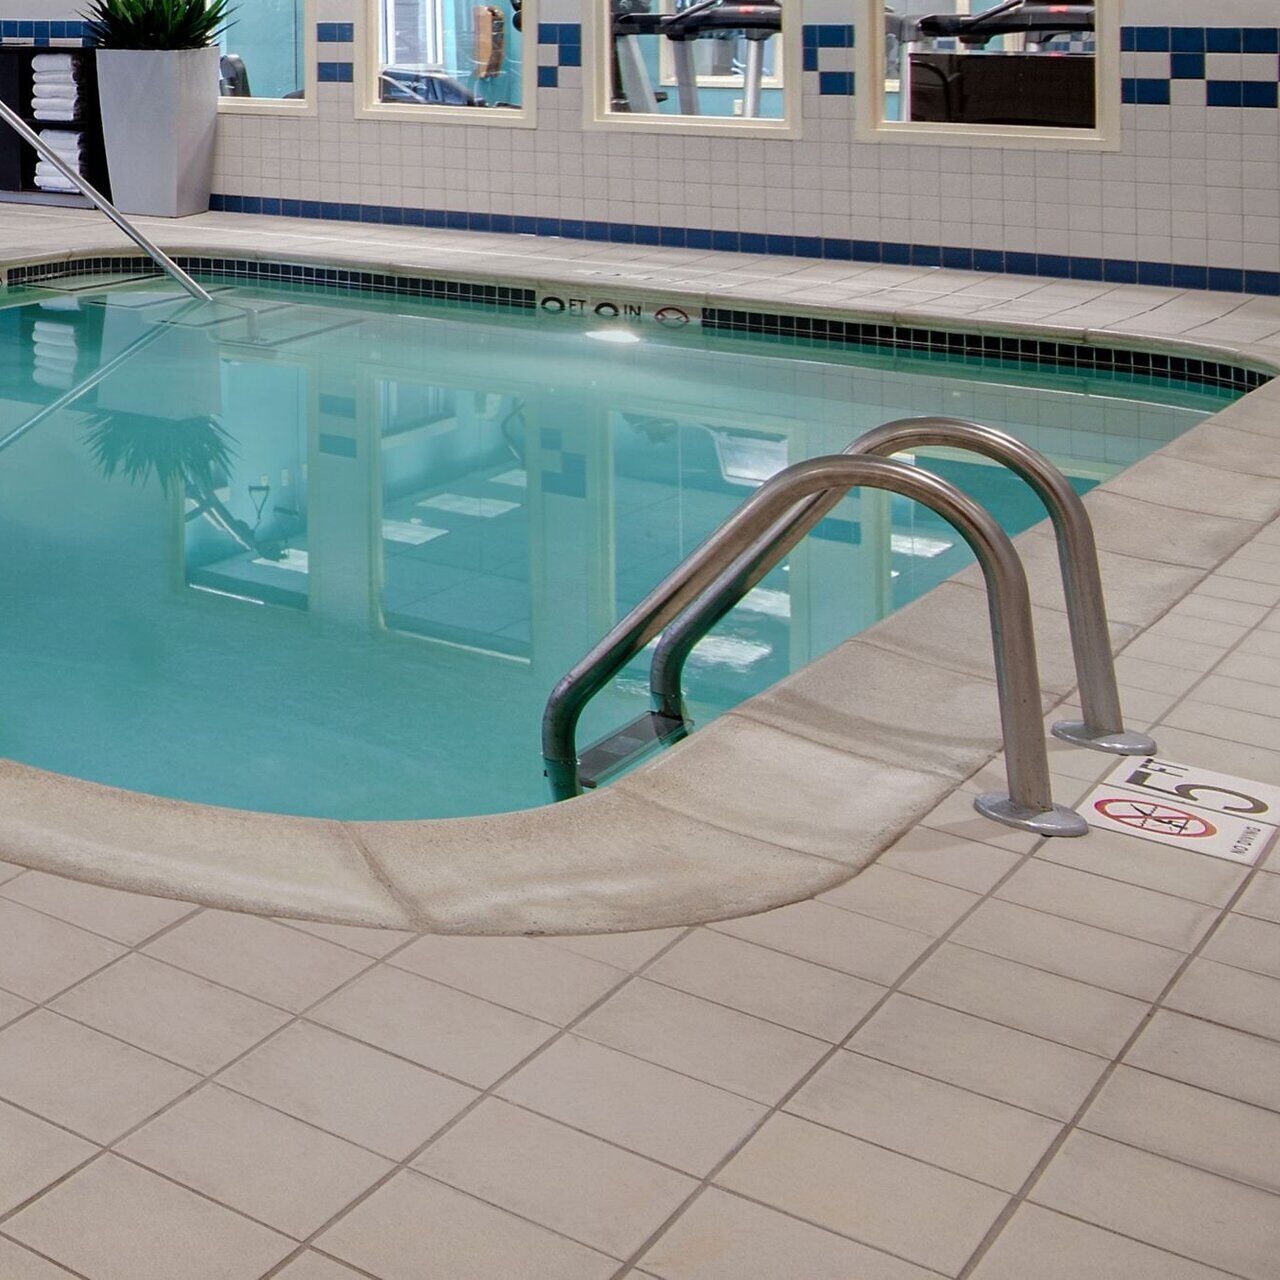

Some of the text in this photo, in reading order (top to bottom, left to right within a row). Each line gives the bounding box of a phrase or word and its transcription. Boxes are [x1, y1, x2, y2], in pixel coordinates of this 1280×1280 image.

[569, 299, 587, 311] FT
[624, 304, 641, 316] IN
[1125, 758, 1269, 814] 5 FT
